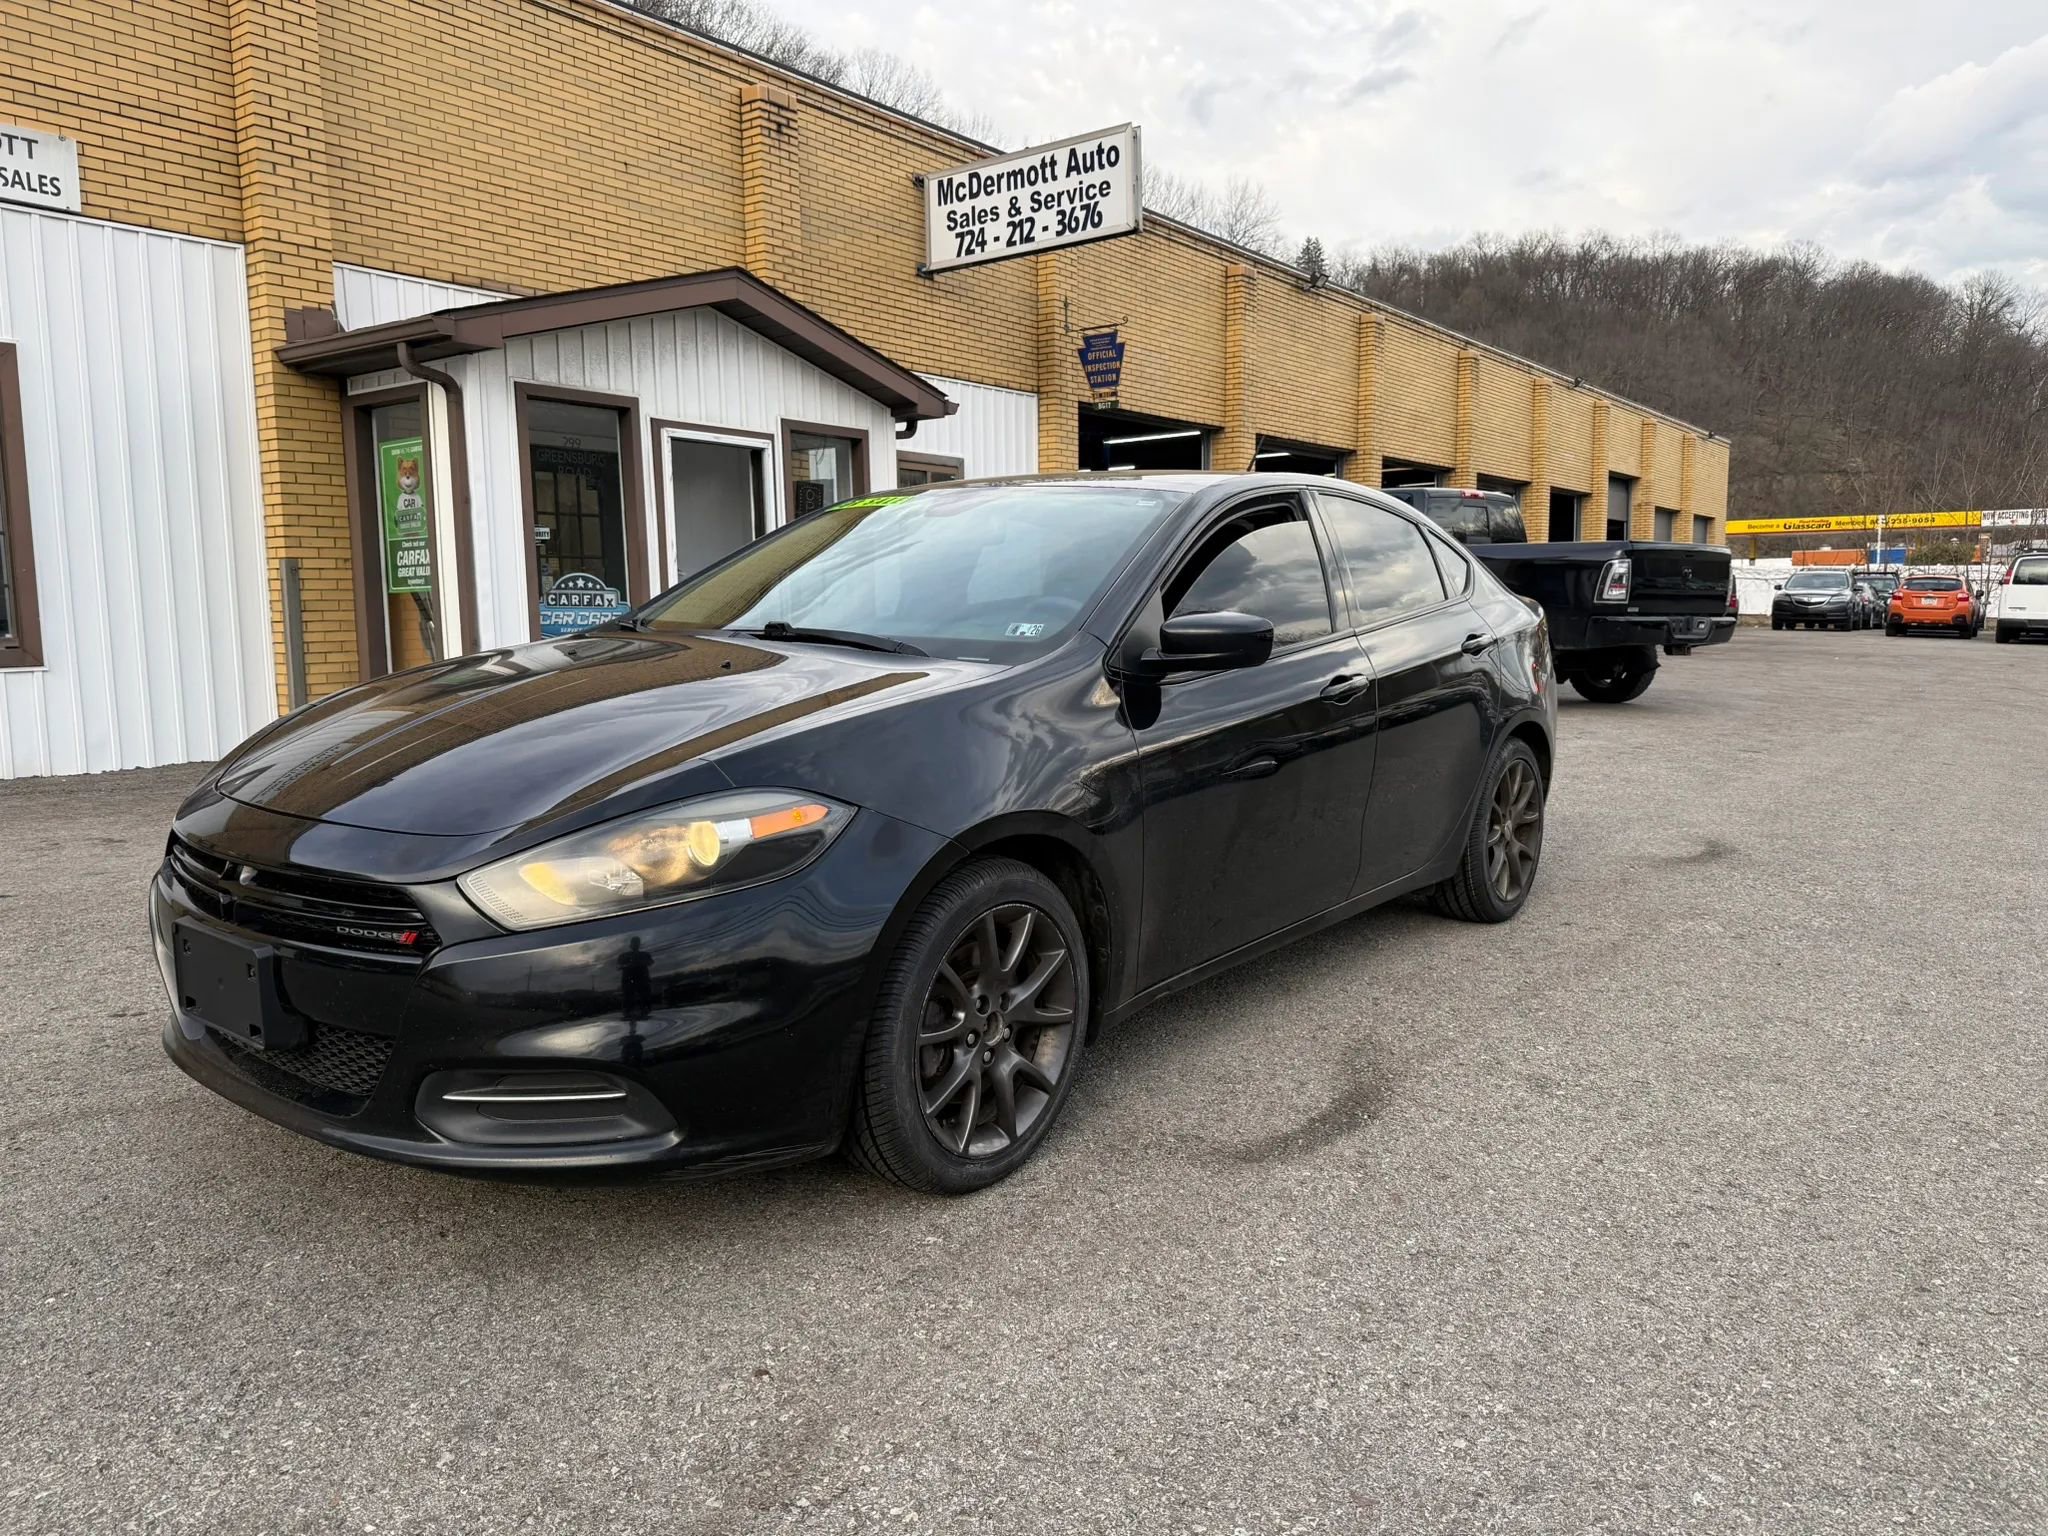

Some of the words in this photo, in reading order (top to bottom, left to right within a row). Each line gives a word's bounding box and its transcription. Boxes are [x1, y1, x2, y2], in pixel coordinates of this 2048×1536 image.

[0, 132, 39, 160] TT
[937, 153, 1058, 207] McDermott
[1065, 141, 1120, 178] Auto
[0, 166, 62, 197] SALES
[946, 205, 1000, 232] Sales
[1007, 196, 1022, 218] &
[1029, 180, 1112, 213] Service
[955, 227, 987, 258] 724
[1006, 216, 1036, 248] 212
[1056, 201, 1103, 237] 3676
[1087, 349, 1117, 360] OFFICIAL
[1085, 361, 1120, 373] INSPECTION
[1090, 373, 1117, 384] STATION
[537, 448, 605, 465] GREENSBURG
[403, 499, 416, 508] CAR
[1998, 511, 2029, 520] ACCEPTING
[1783, 521, 1832, 530] Glasscard
[398, 566, 416, 578] GREAT
[416, 566, 430, 577] VALU
[547, 594, 617, 607] CARFAX
[540, 611, 575, 625] CAR
[336, 926, 404, 941] DODGE
